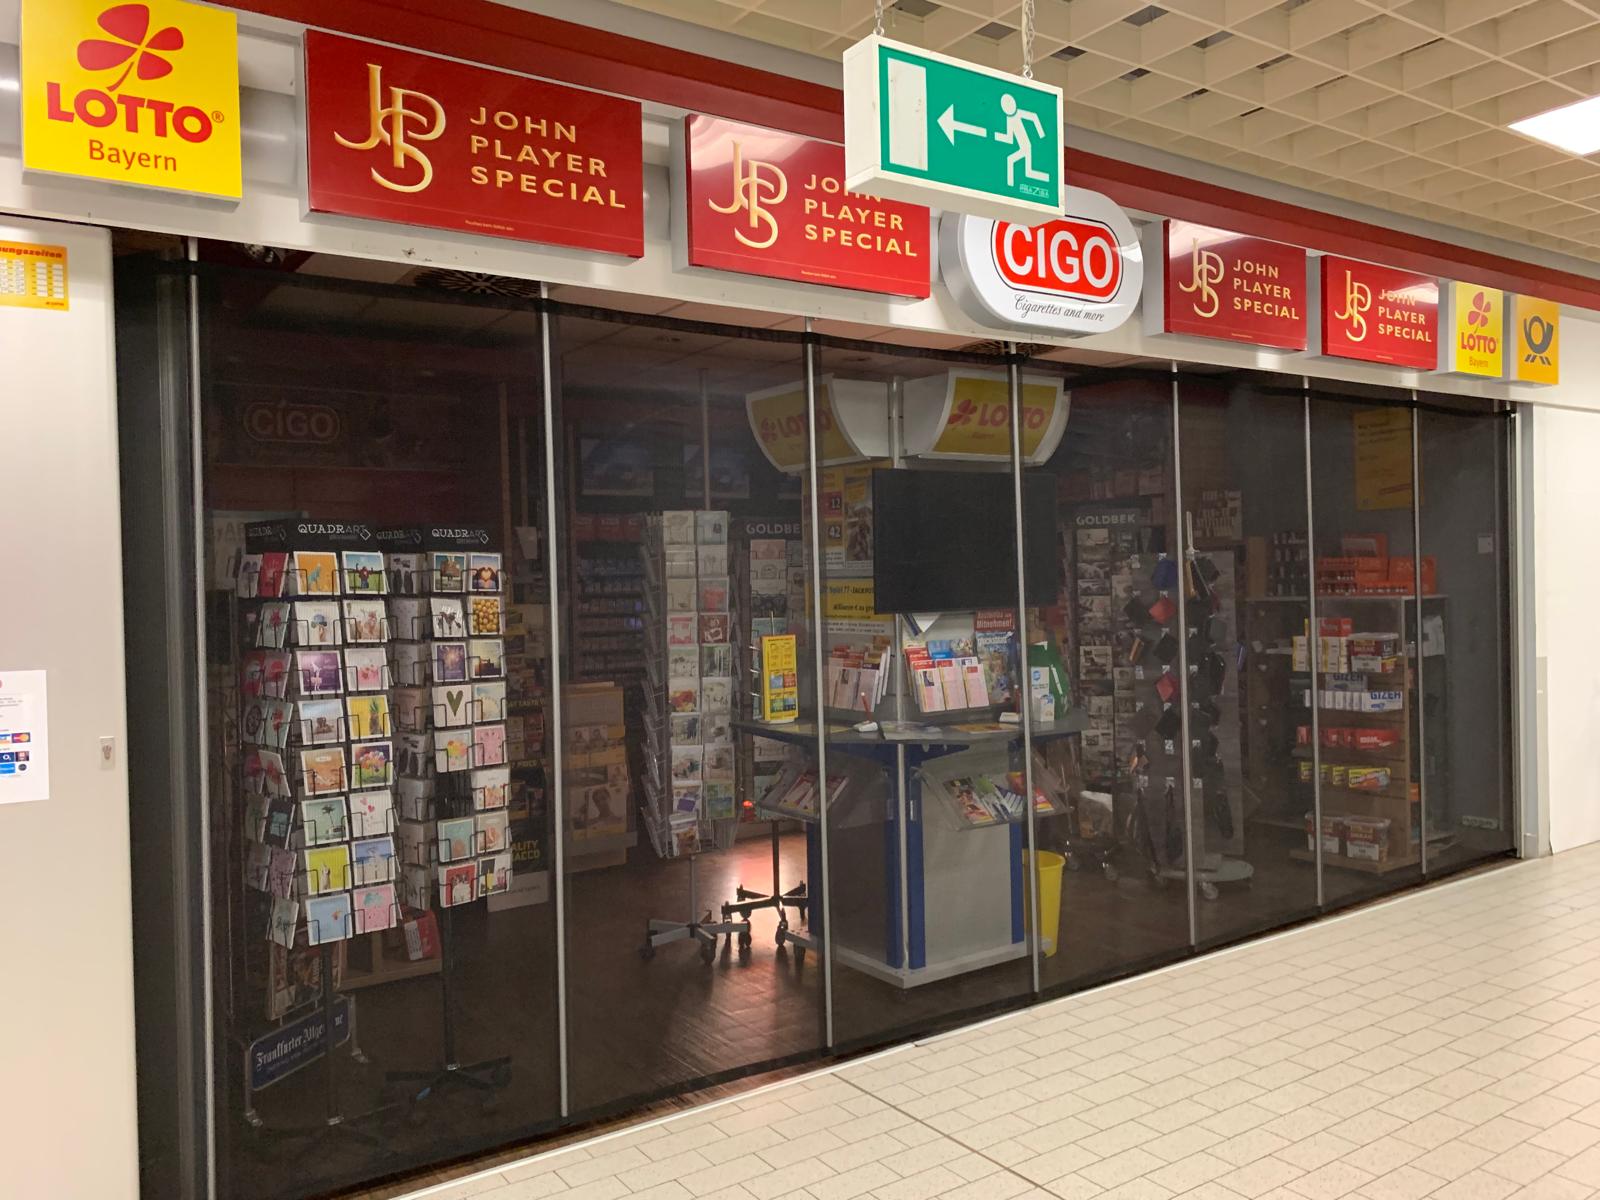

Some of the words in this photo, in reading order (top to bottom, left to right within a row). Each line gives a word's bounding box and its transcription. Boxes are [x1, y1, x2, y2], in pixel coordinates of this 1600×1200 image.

[470, 106, 577, 143] JOHN
[88, 139, 177, 172] Bayern
[470, 135, 608, 178] PLAYER
[470, 166, 627, 209] SPECIAL
[804, 198, 904, 231] PLAYER
[804, 223, 918, 257] SPECIAL
[0, 246, 63, 259] ungszeiten
[1003, 223, 1114, 289] CIGO
[1233, 258, 1280, 280] JOHN
[1233, 277, 1292, 300] PLAYER
[1378, 288, 1417, 307] JOHN
[1014, 293, 1062, 319] Cigarettes
[1063, 307, 1082, 318] and
[1083, 311, 1105, 322] more
[1233, 298, 1300, 321] SPECIAL
[1378, 306, 1427, 325] PLAYER
[1378, 322, 1432, 343] SPECIAL
[1468, 355, 1489, 368] Bayern
[251, 408, 335, 438] CIGO
[745, 522, 801, 535] GOLDBE
[1075, 513, 1136, 526] GOLDBEK
[1370, 690, 1402, 700] GIZEH
